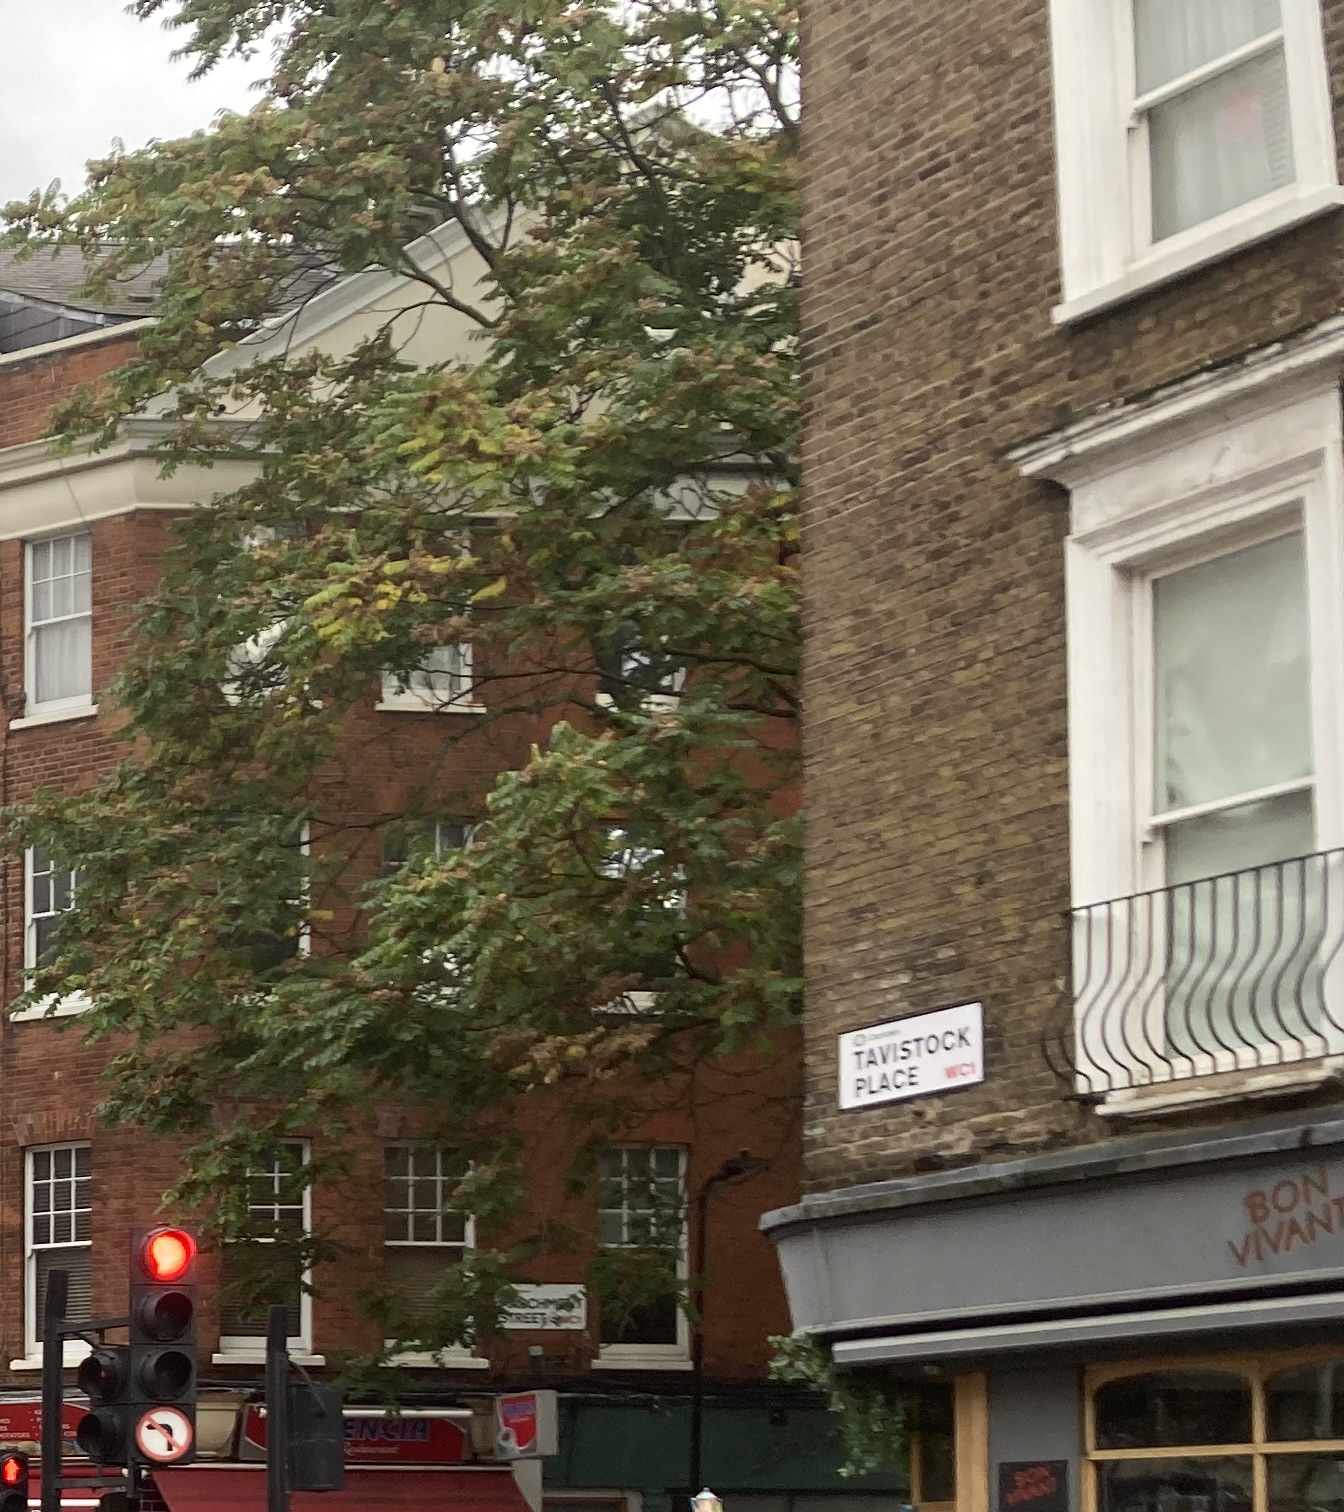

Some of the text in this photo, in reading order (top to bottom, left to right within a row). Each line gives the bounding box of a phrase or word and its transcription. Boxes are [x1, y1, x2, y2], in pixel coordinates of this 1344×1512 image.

[853, 1026, 971, 1070] TAVISTOCK
[855, 1066, 920, 1098] PLACE
[1244, 1167, 1329, 1224] BON
[343, 1416, 431, 1441] ENCIA
